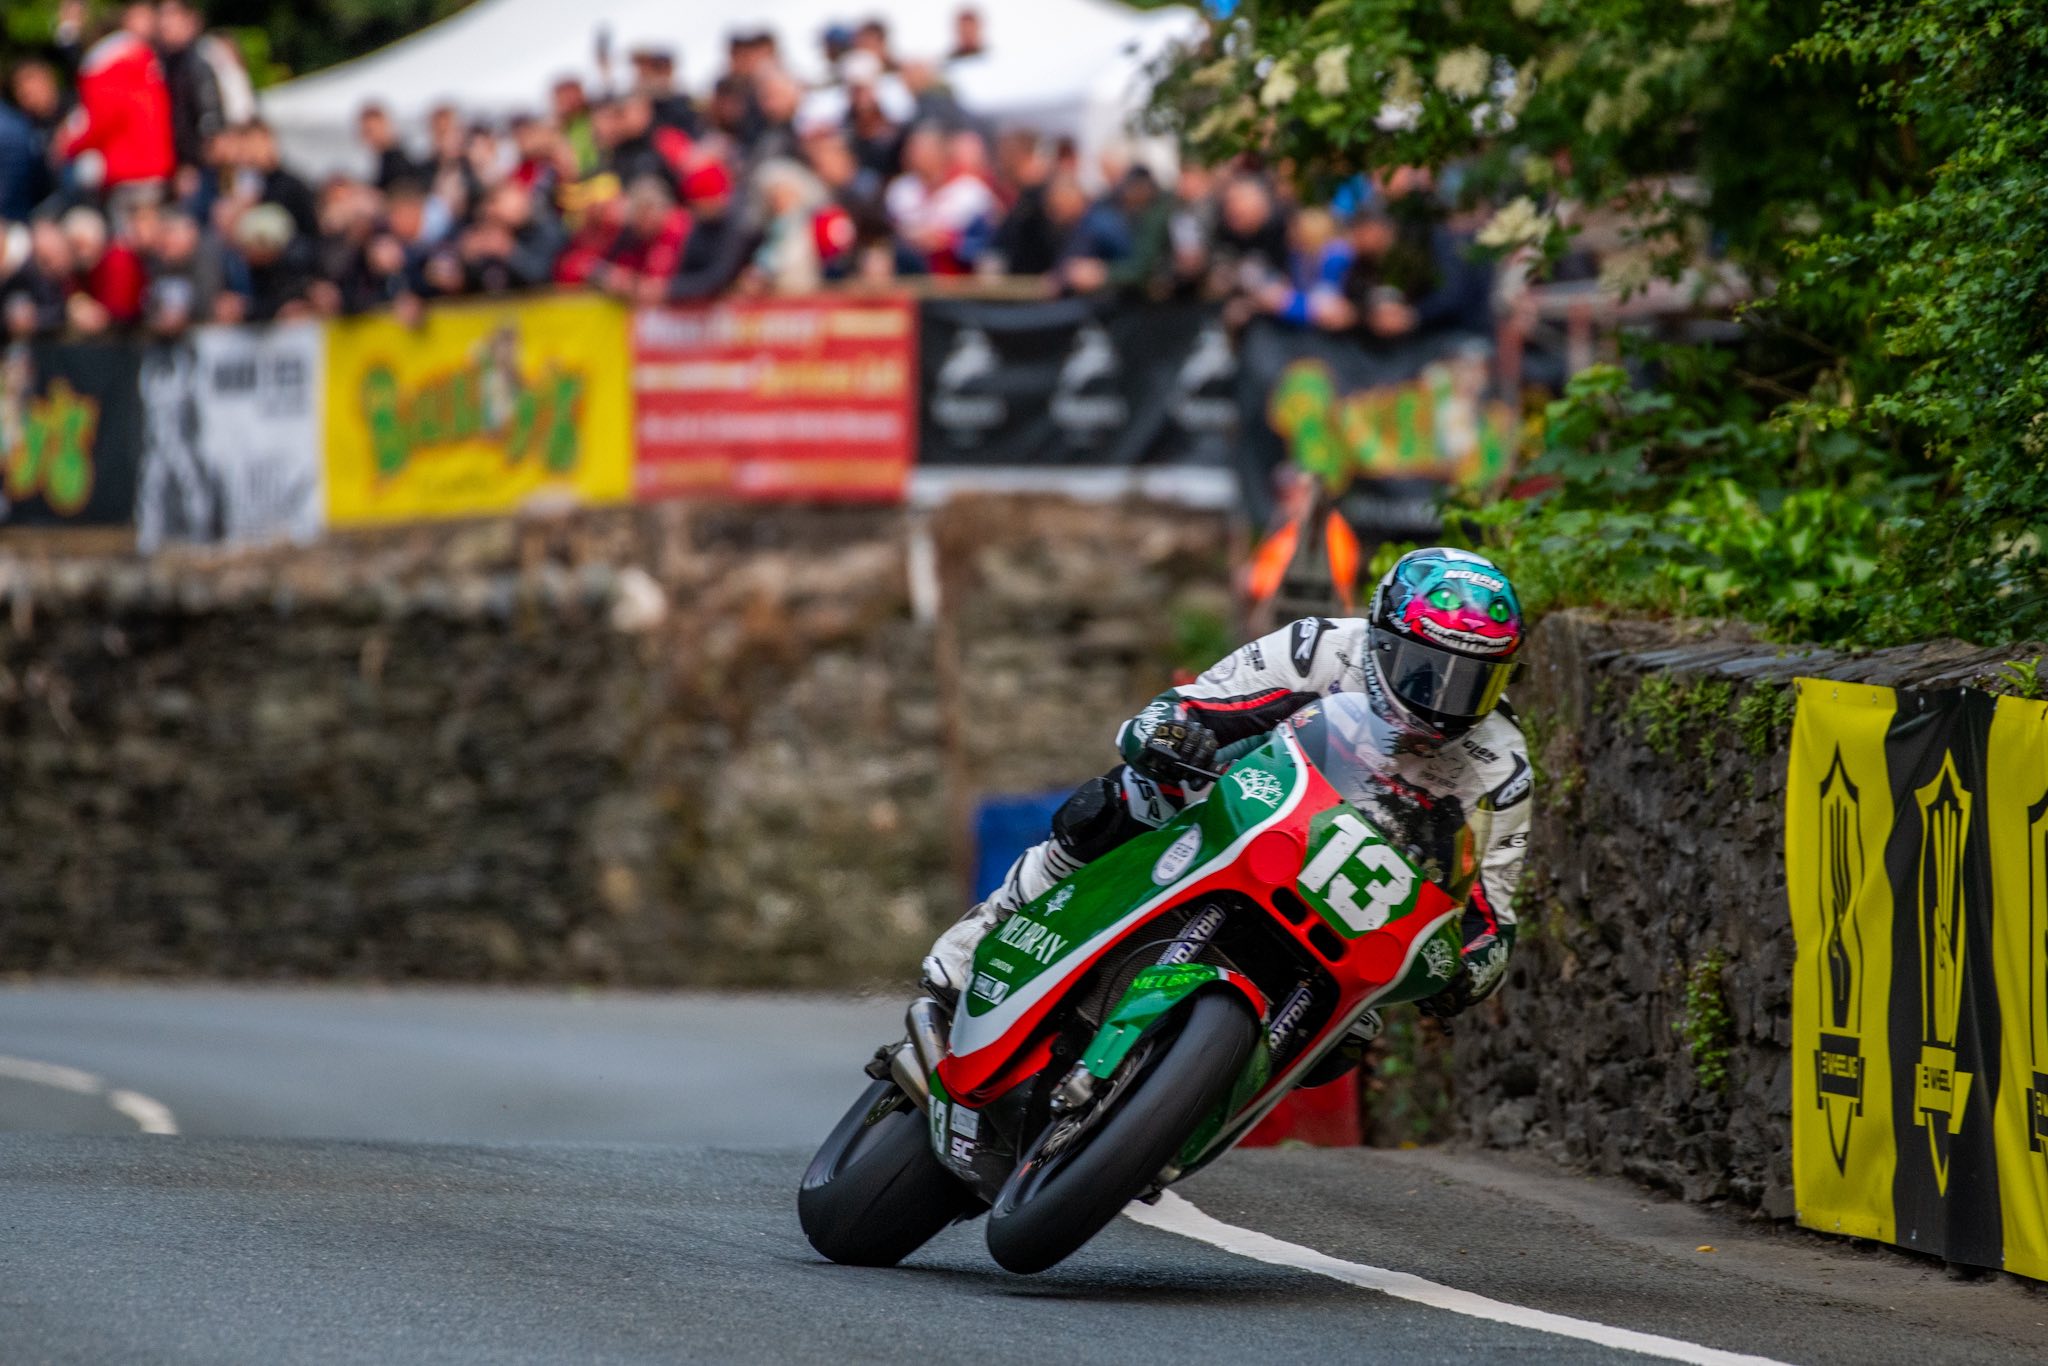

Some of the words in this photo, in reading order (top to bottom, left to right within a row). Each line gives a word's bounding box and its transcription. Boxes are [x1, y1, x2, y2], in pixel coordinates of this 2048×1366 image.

[1443, 570, 1504, 593] NOLAN
[1462, 740, 1501, 763] OLAN
[1297, 814, 1419, 932] 13
[995, 913, 1068, 964] MELBRAY
